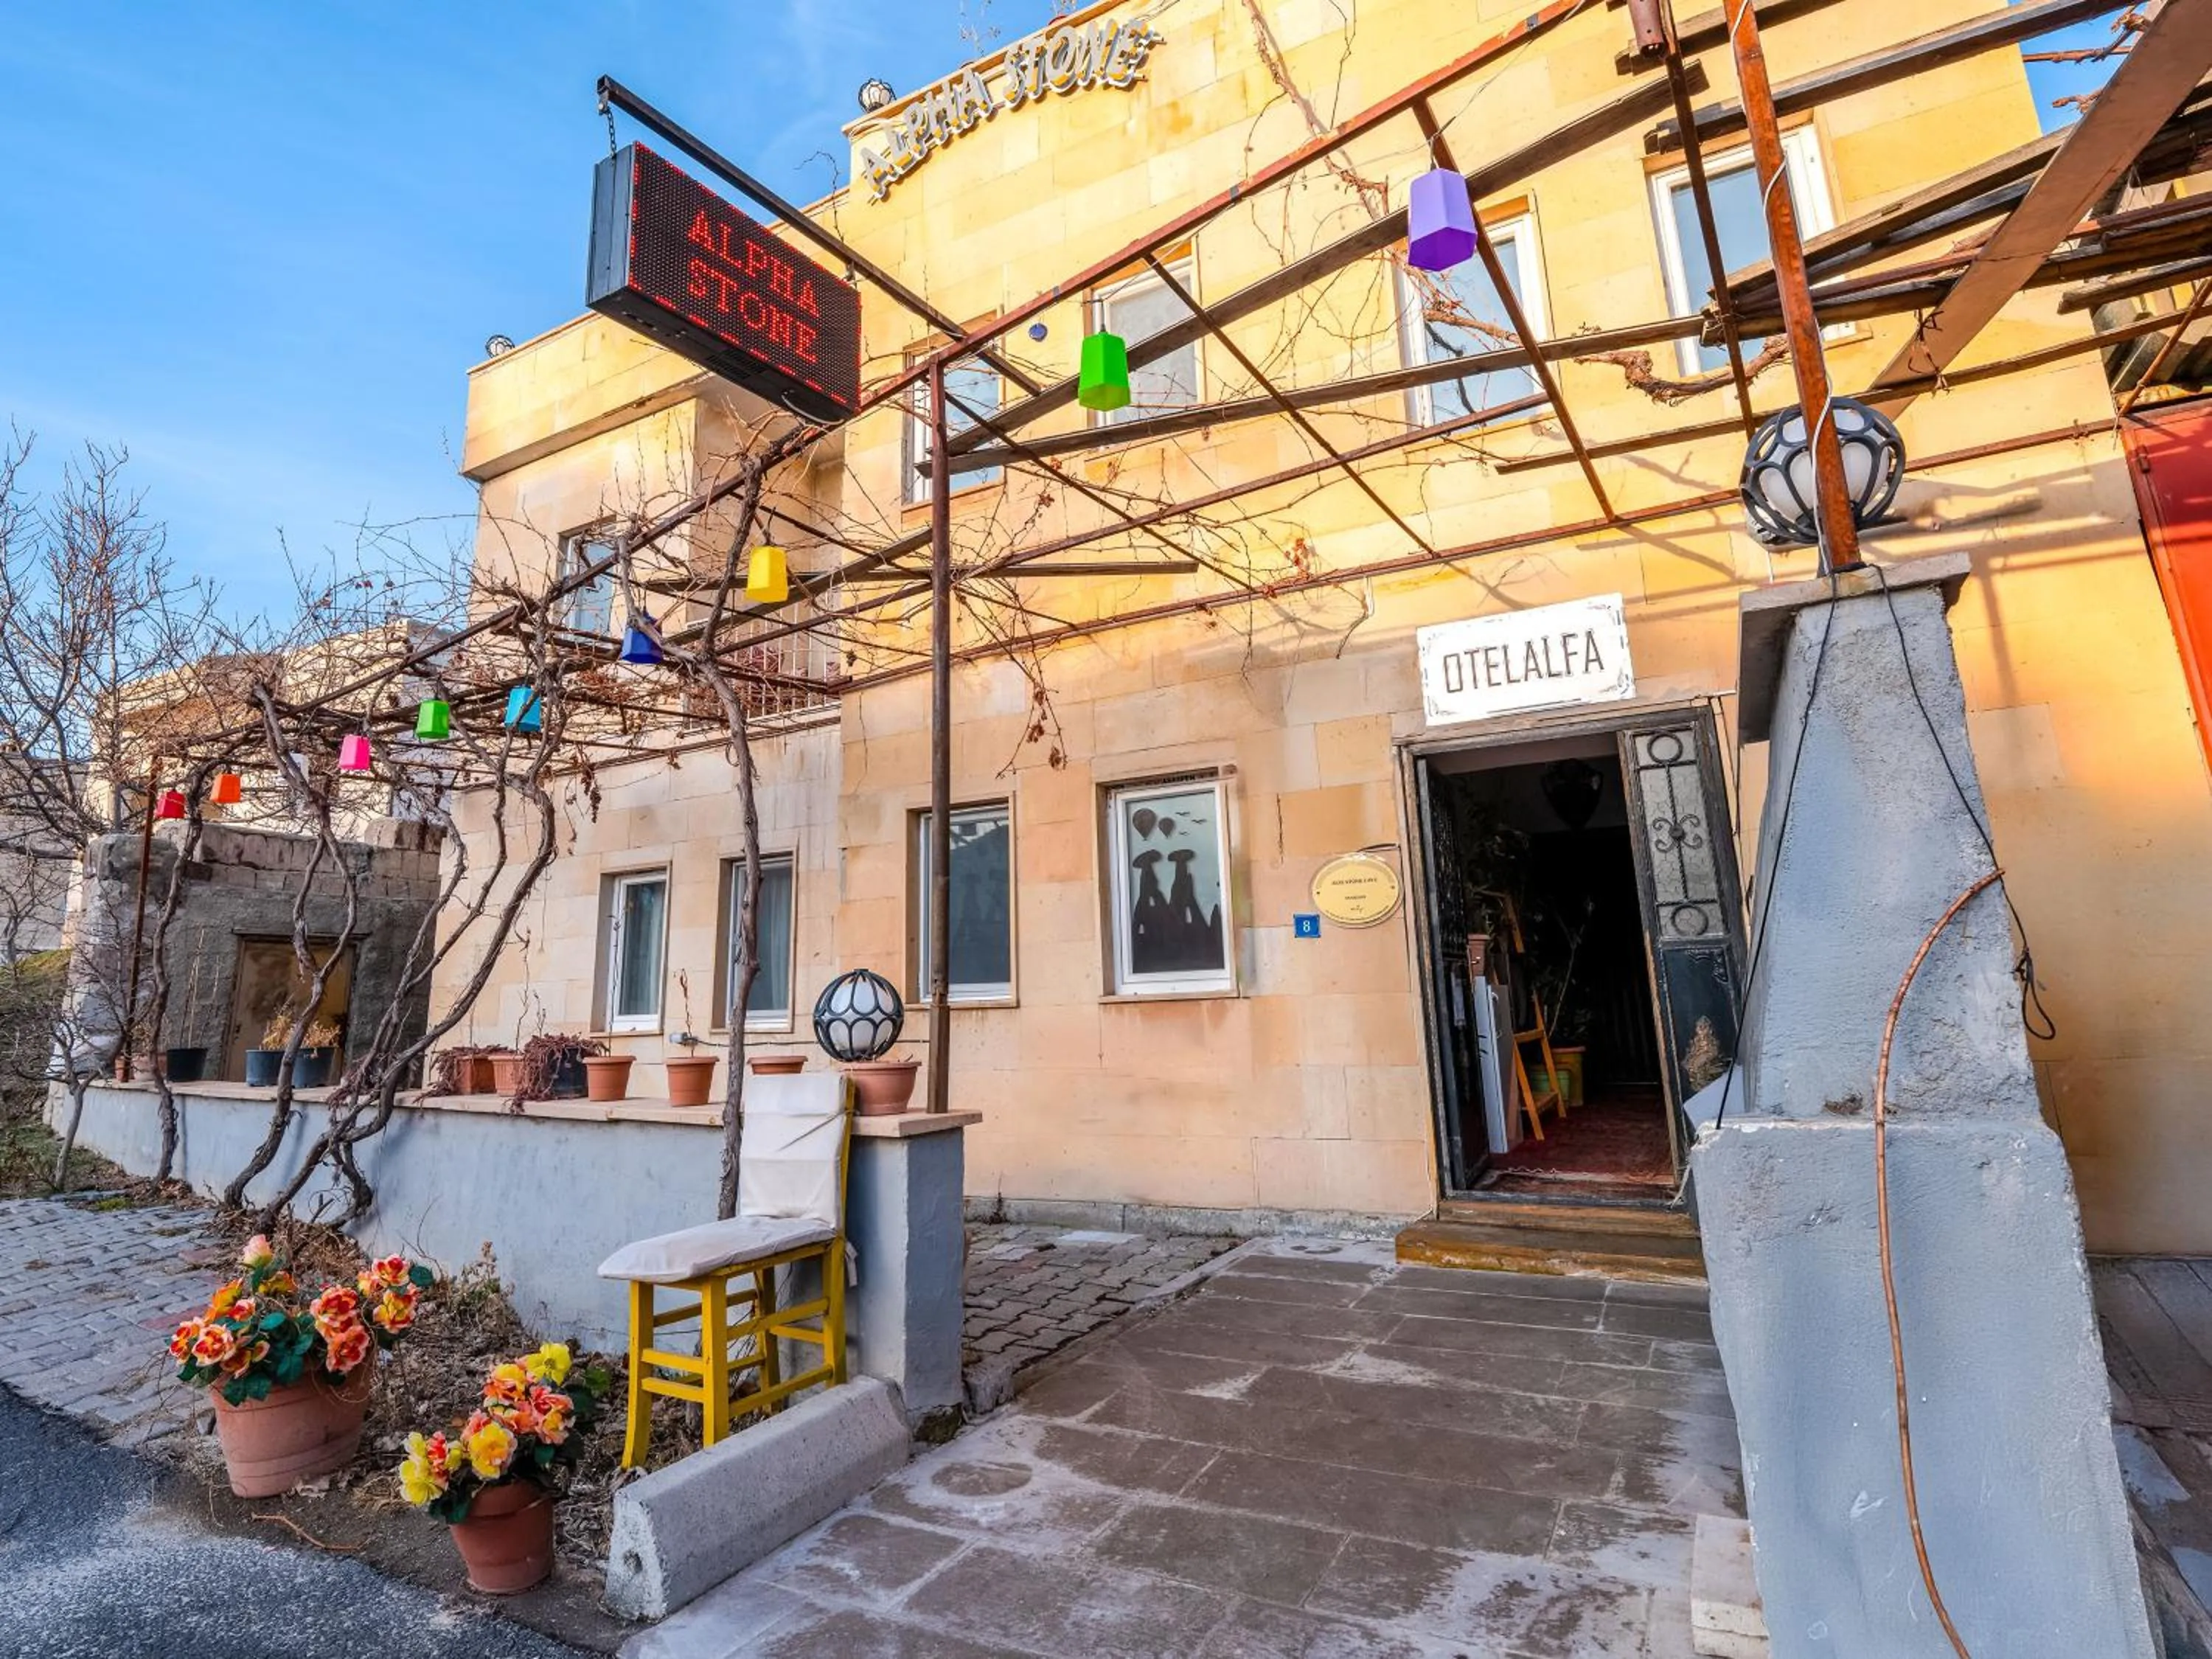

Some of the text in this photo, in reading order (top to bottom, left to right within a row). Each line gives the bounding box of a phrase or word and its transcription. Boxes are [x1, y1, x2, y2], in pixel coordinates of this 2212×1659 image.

[860, 18, 1156, 198] ALPHA STONE
[686, 209, 819, 318] ALPHA
[686, 258, 817, 364] STONE
[1303, 920, 1310, 933] 8
